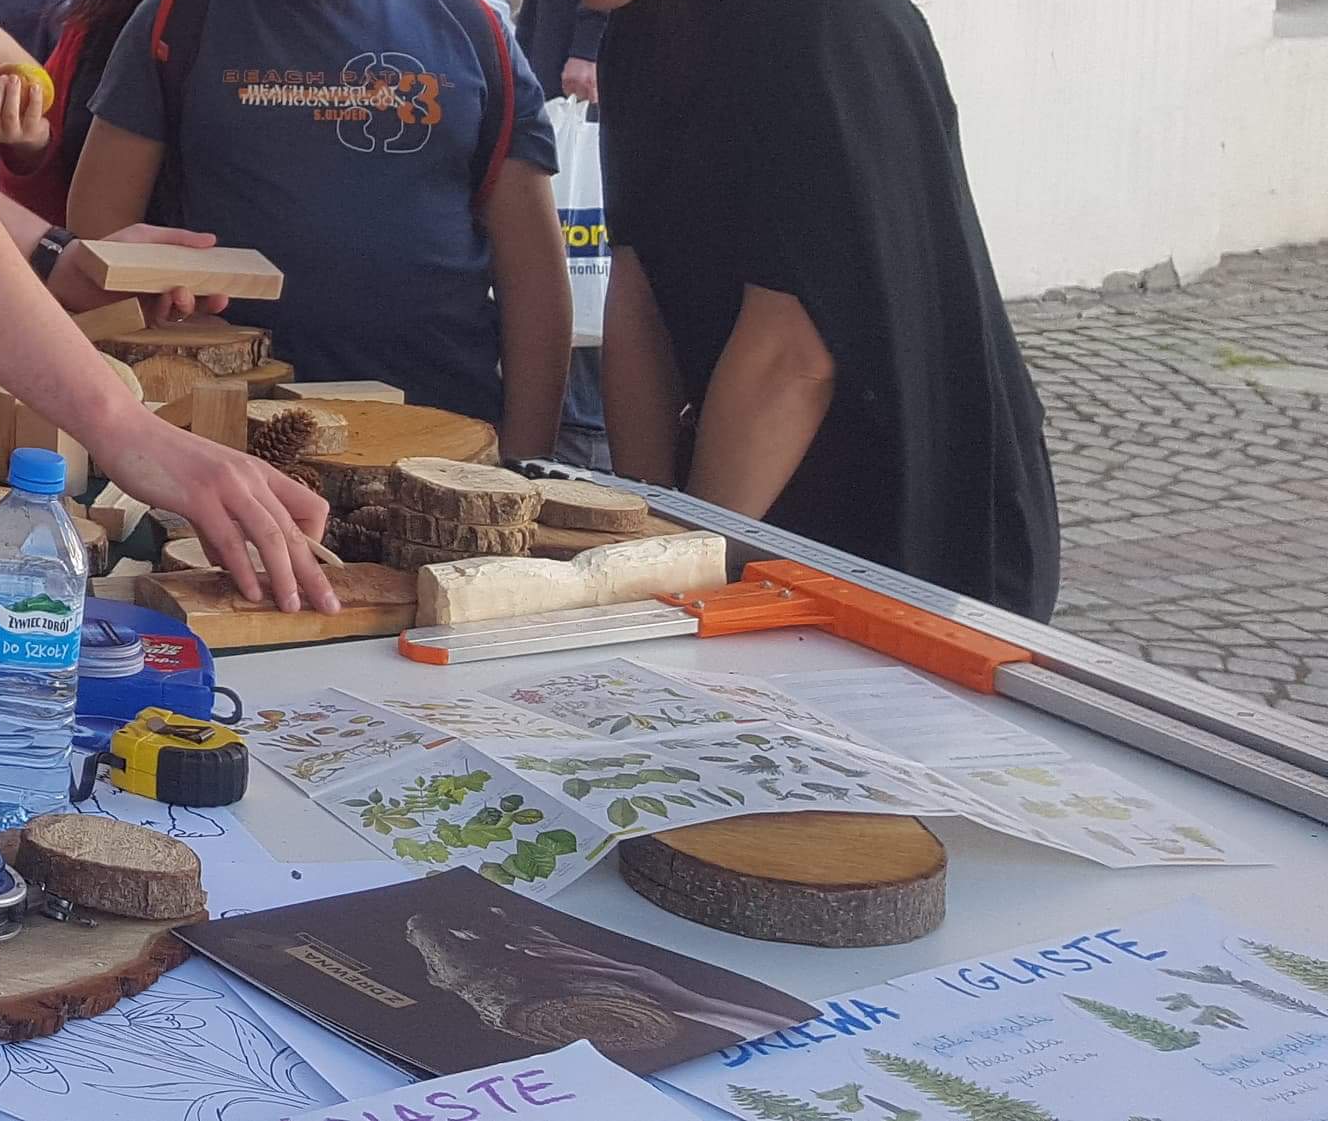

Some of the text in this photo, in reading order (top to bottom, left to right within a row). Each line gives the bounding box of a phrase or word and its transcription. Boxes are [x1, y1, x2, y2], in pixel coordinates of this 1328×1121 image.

[2, 640, 69, 660] DO SZKOŁY
[934, 927, 1168, 999] IGLASTE
